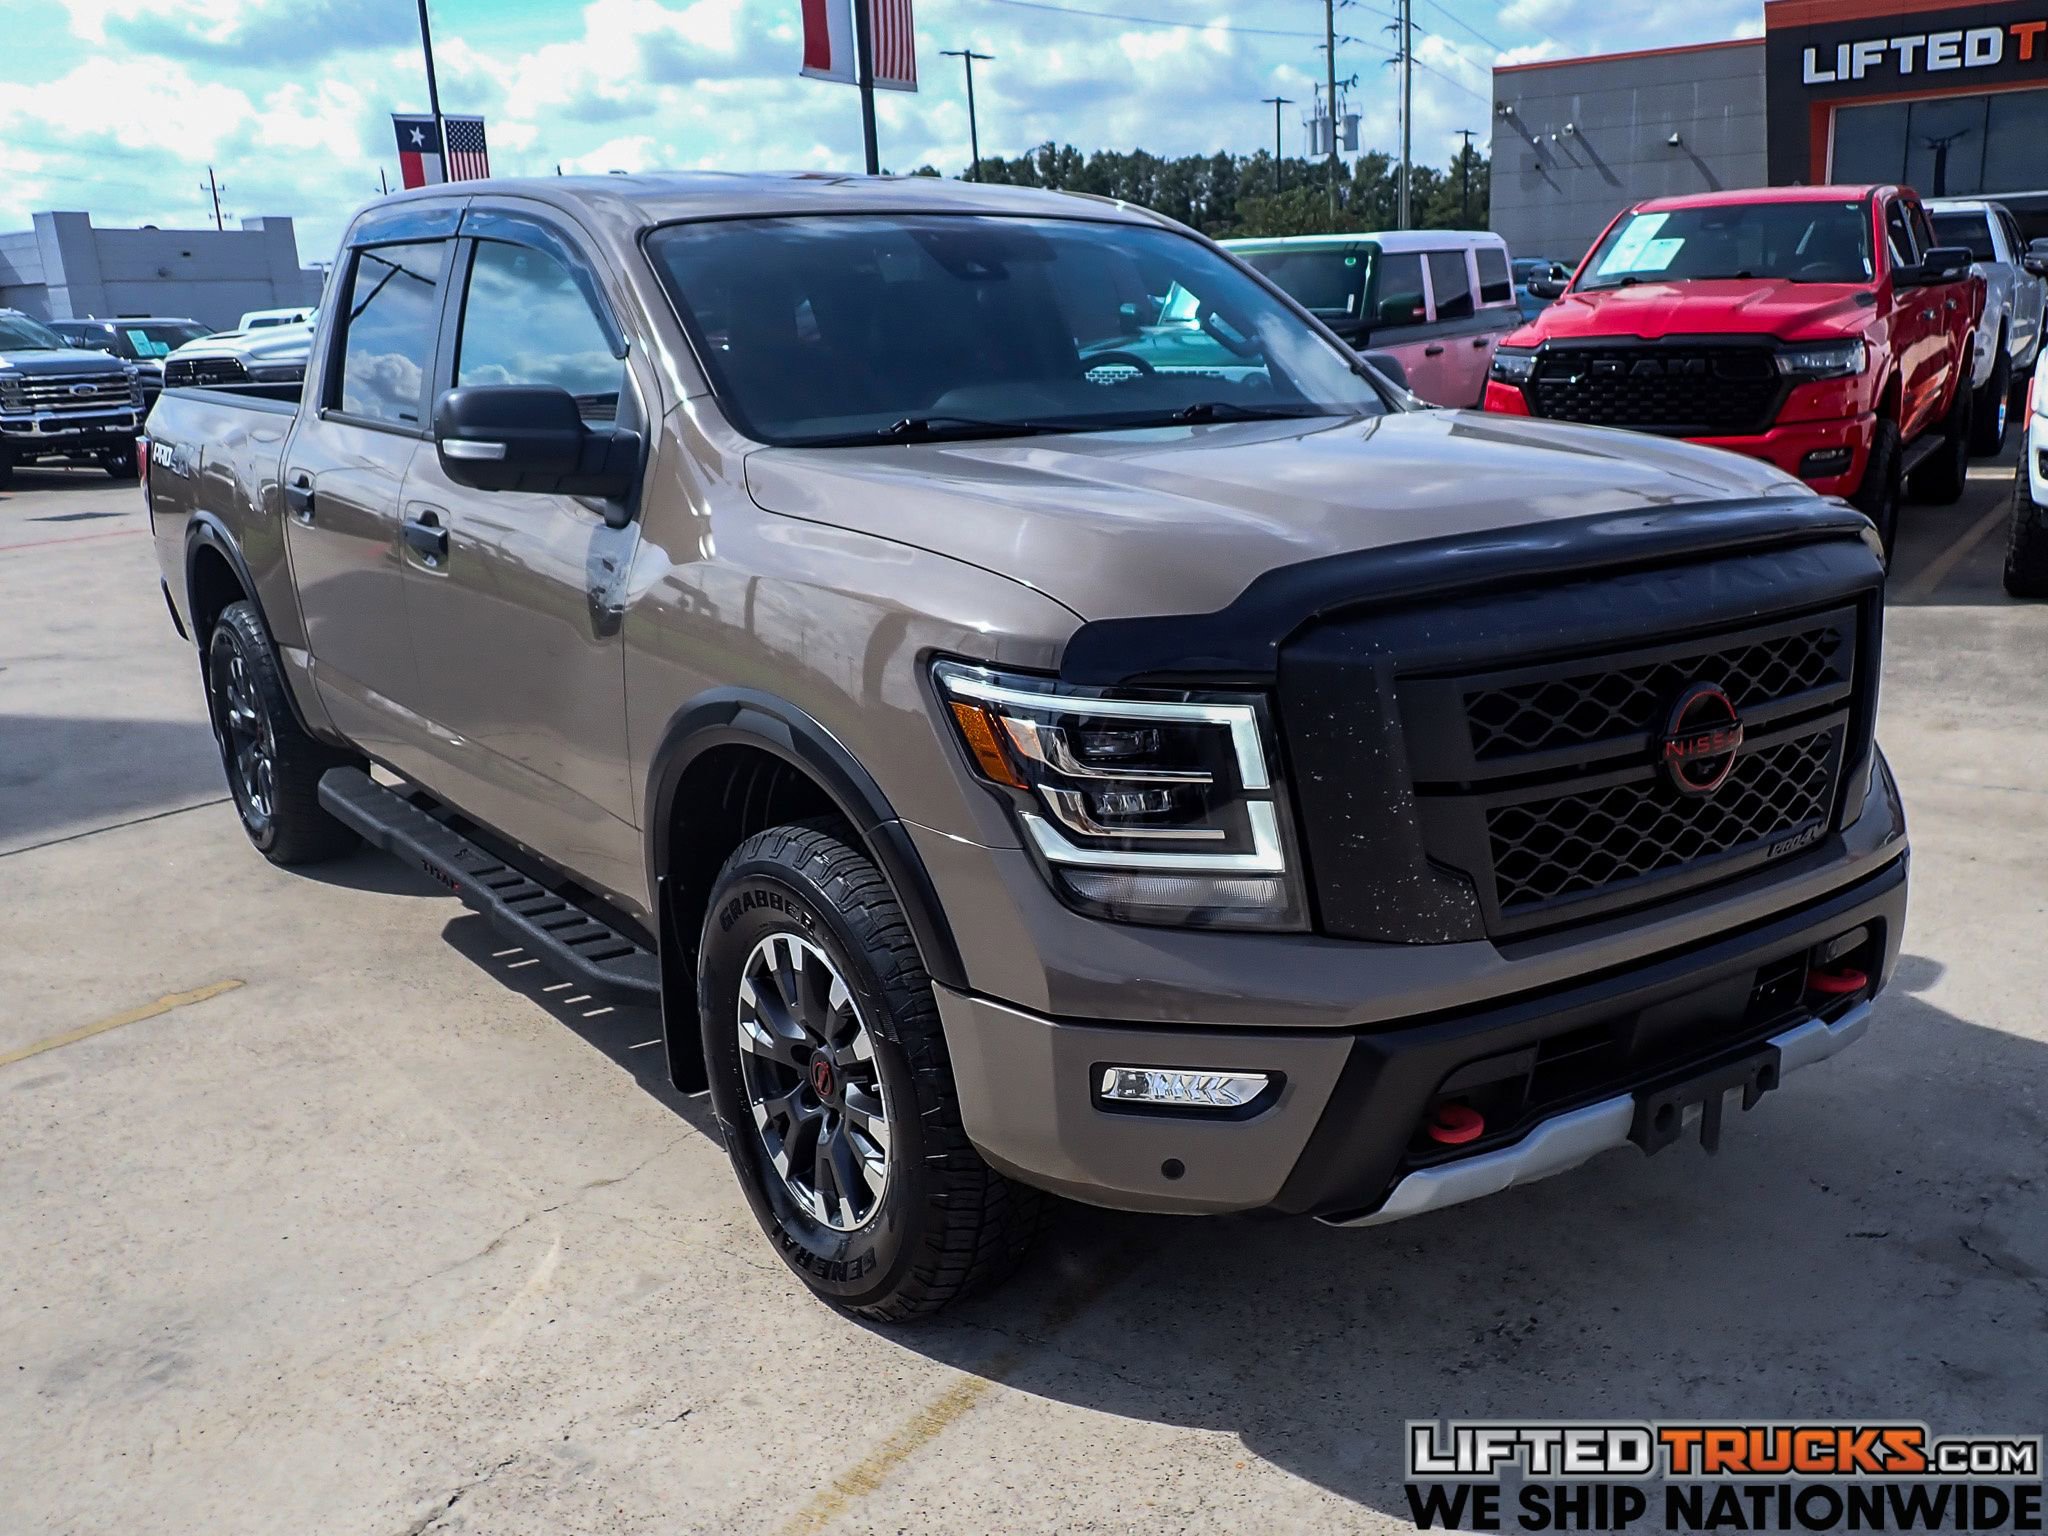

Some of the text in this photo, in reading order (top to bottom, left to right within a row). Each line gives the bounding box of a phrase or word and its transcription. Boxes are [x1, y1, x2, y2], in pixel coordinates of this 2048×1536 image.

[1803, 26, 2004, 84] LIFTED
[1592, 359, 1705, 376] RAM
[719, 889, 816, 936] GRABBER
